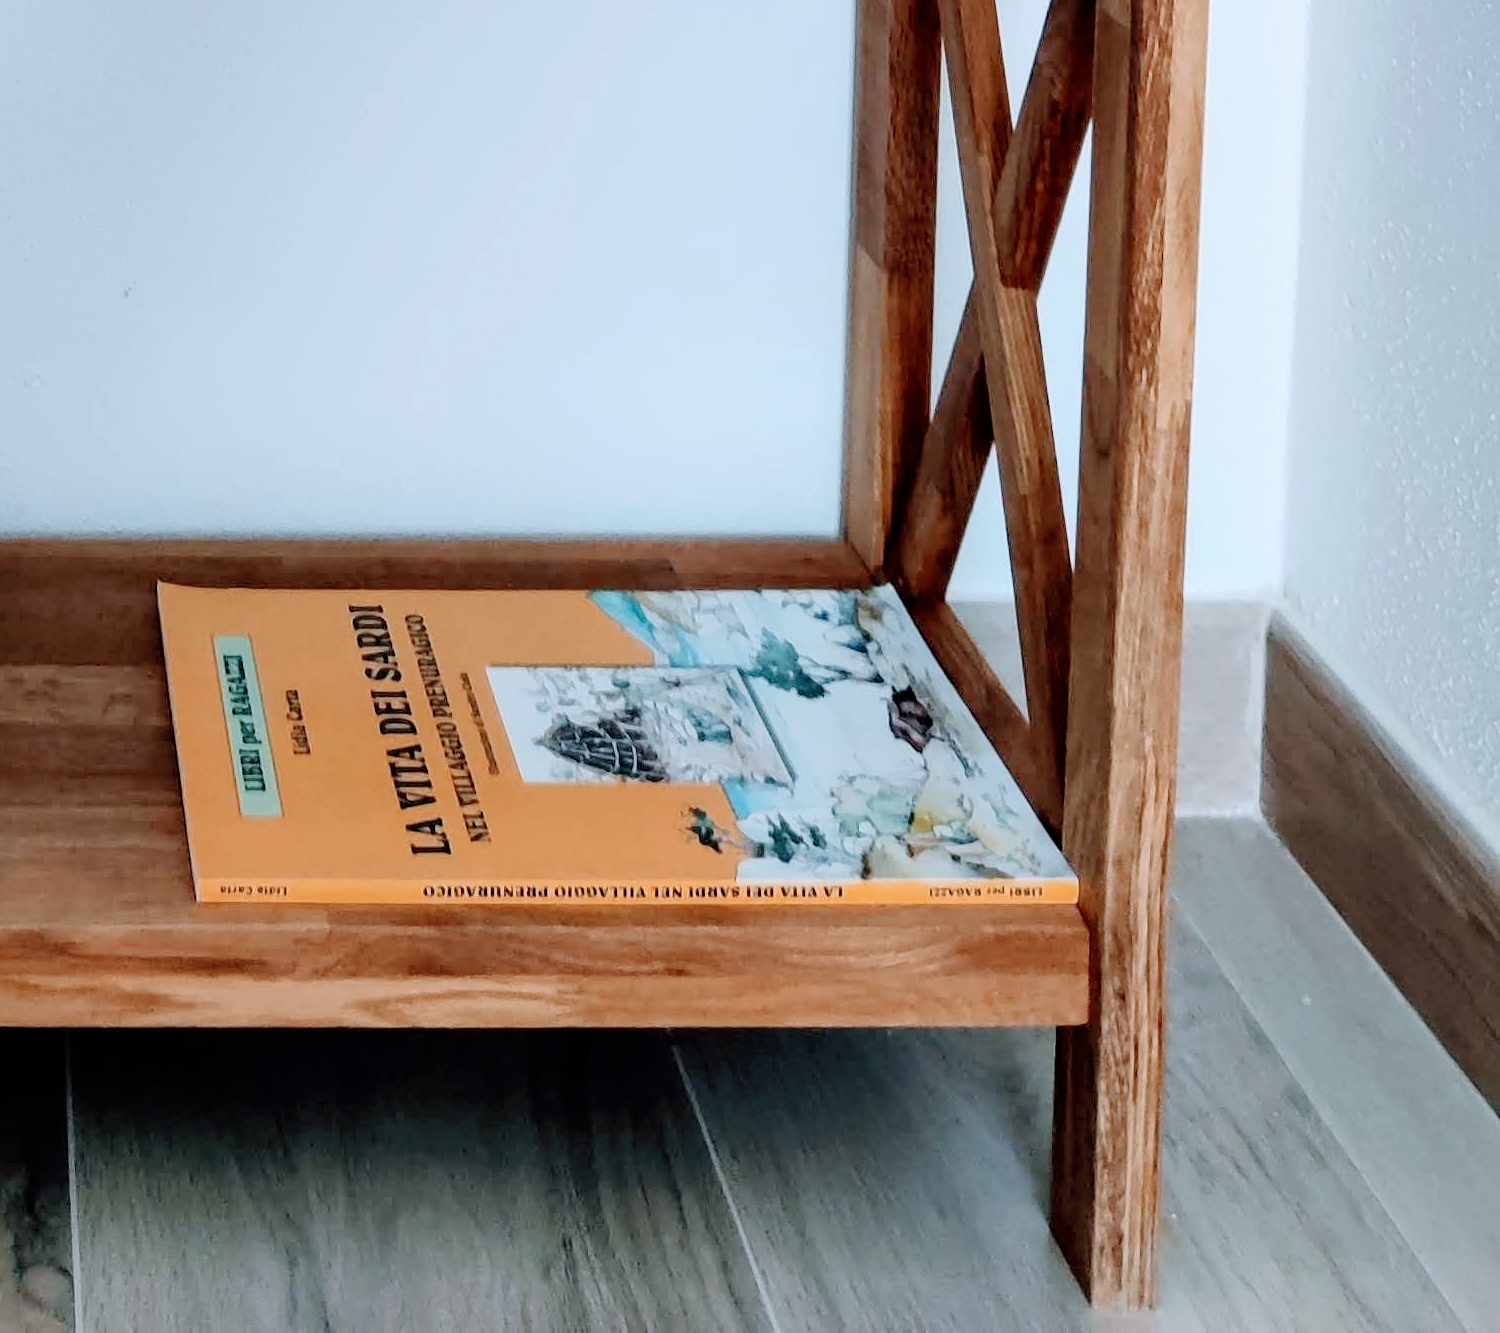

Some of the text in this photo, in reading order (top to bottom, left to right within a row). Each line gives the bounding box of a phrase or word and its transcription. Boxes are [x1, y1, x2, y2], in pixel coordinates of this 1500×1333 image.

[404, 613, 453, 719] PRENURAGICO
[222, 654, 267, 793] LIBRI per RAGAZZI
[348, 604, 452, 856] LA VITA DEI SARDI
[435, 722, 481, 808] VILLAGGIO
[462, 811, 492, 844] NEL
[422, 885, 741, 900] SARDI VILLAGGIO PRENURAGICO
